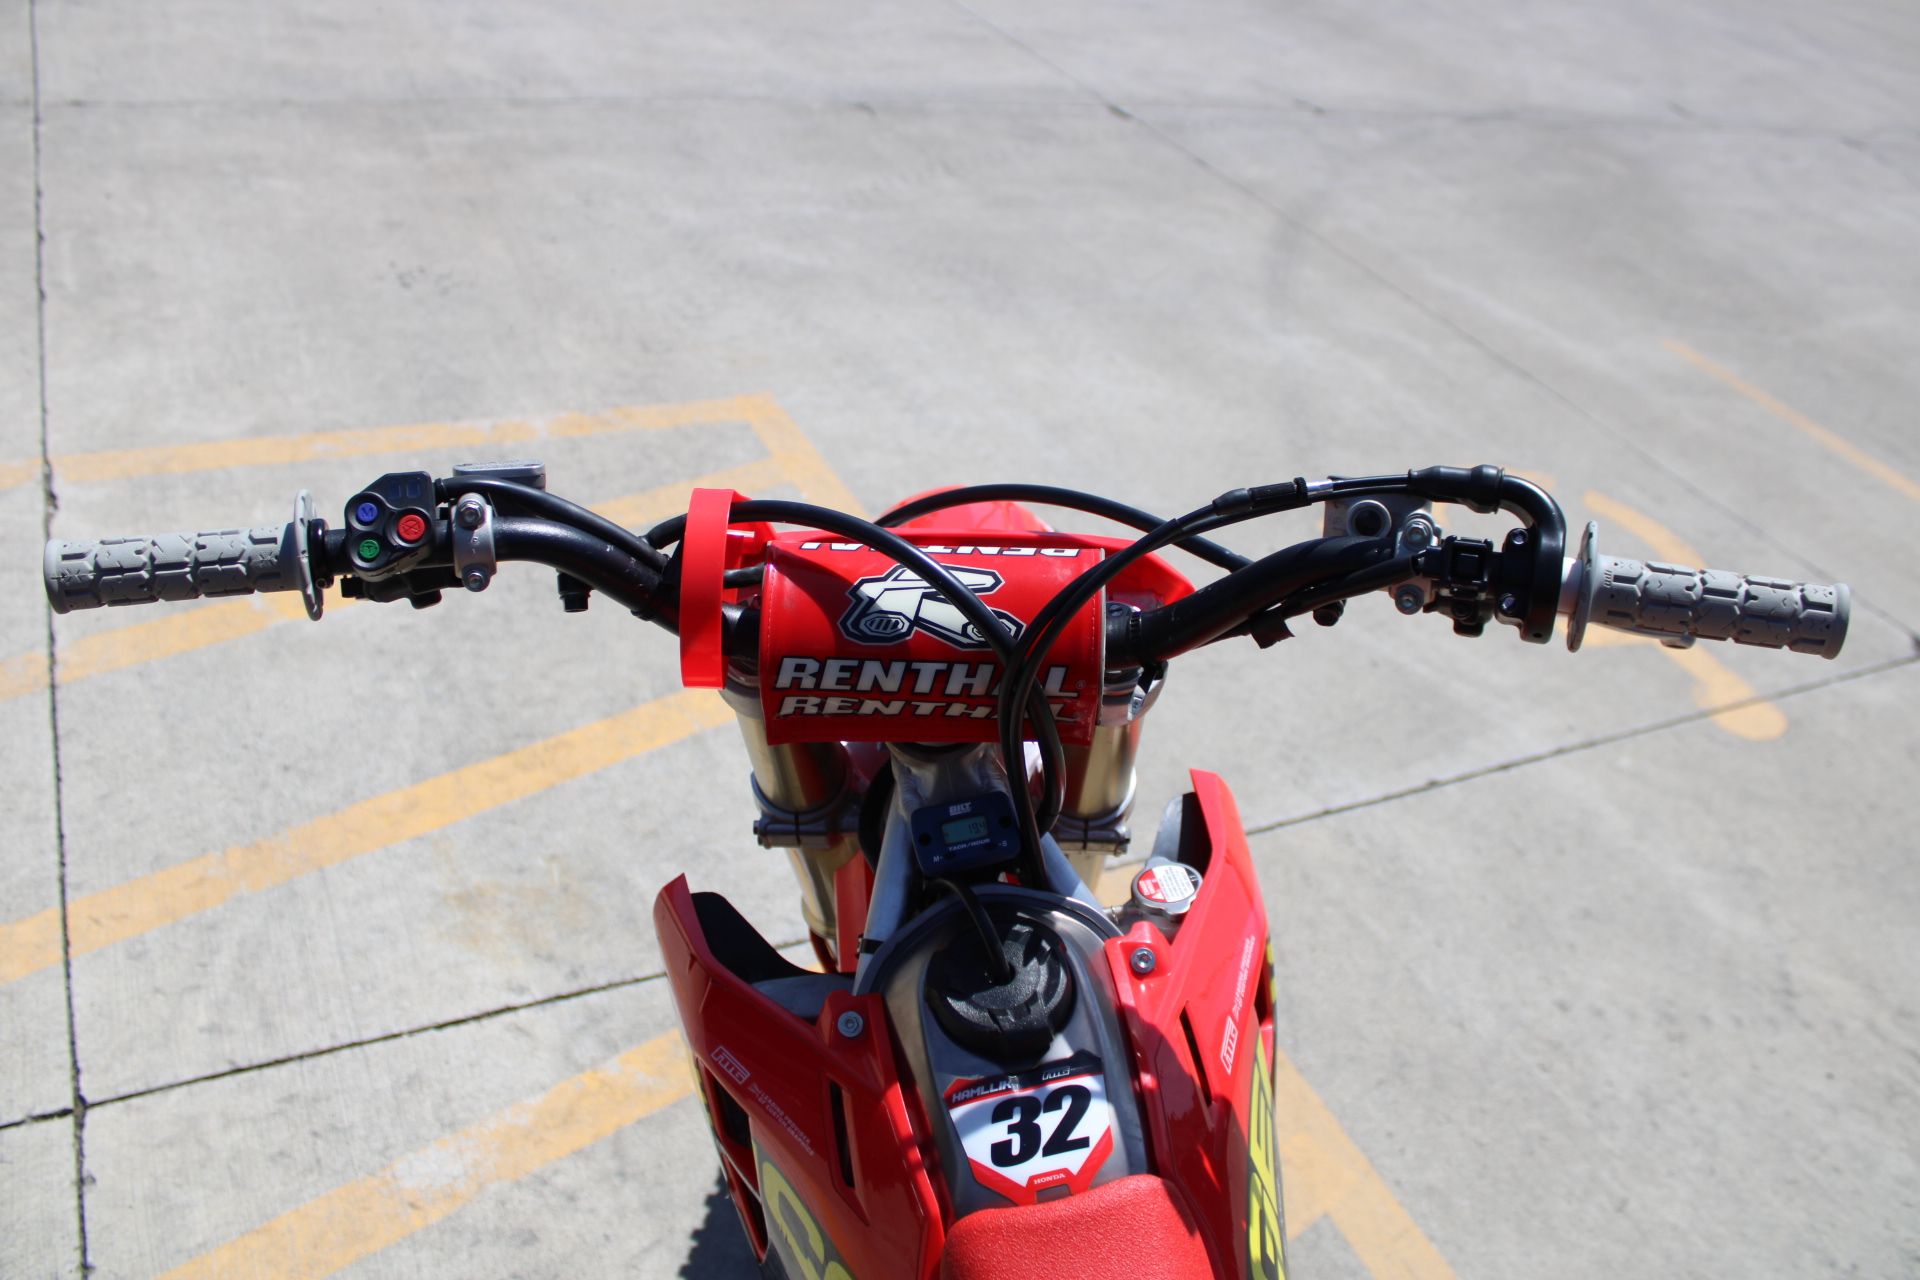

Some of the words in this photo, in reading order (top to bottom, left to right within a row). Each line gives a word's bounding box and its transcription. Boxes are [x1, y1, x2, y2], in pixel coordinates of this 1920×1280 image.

[775, 657, 1079, 698] RENTHL
[779, 696, 1079, 722] RENTHL
[991, 1085, 1092, 1168] 32
[1033, 1172, 1066, 1185] HONDA
